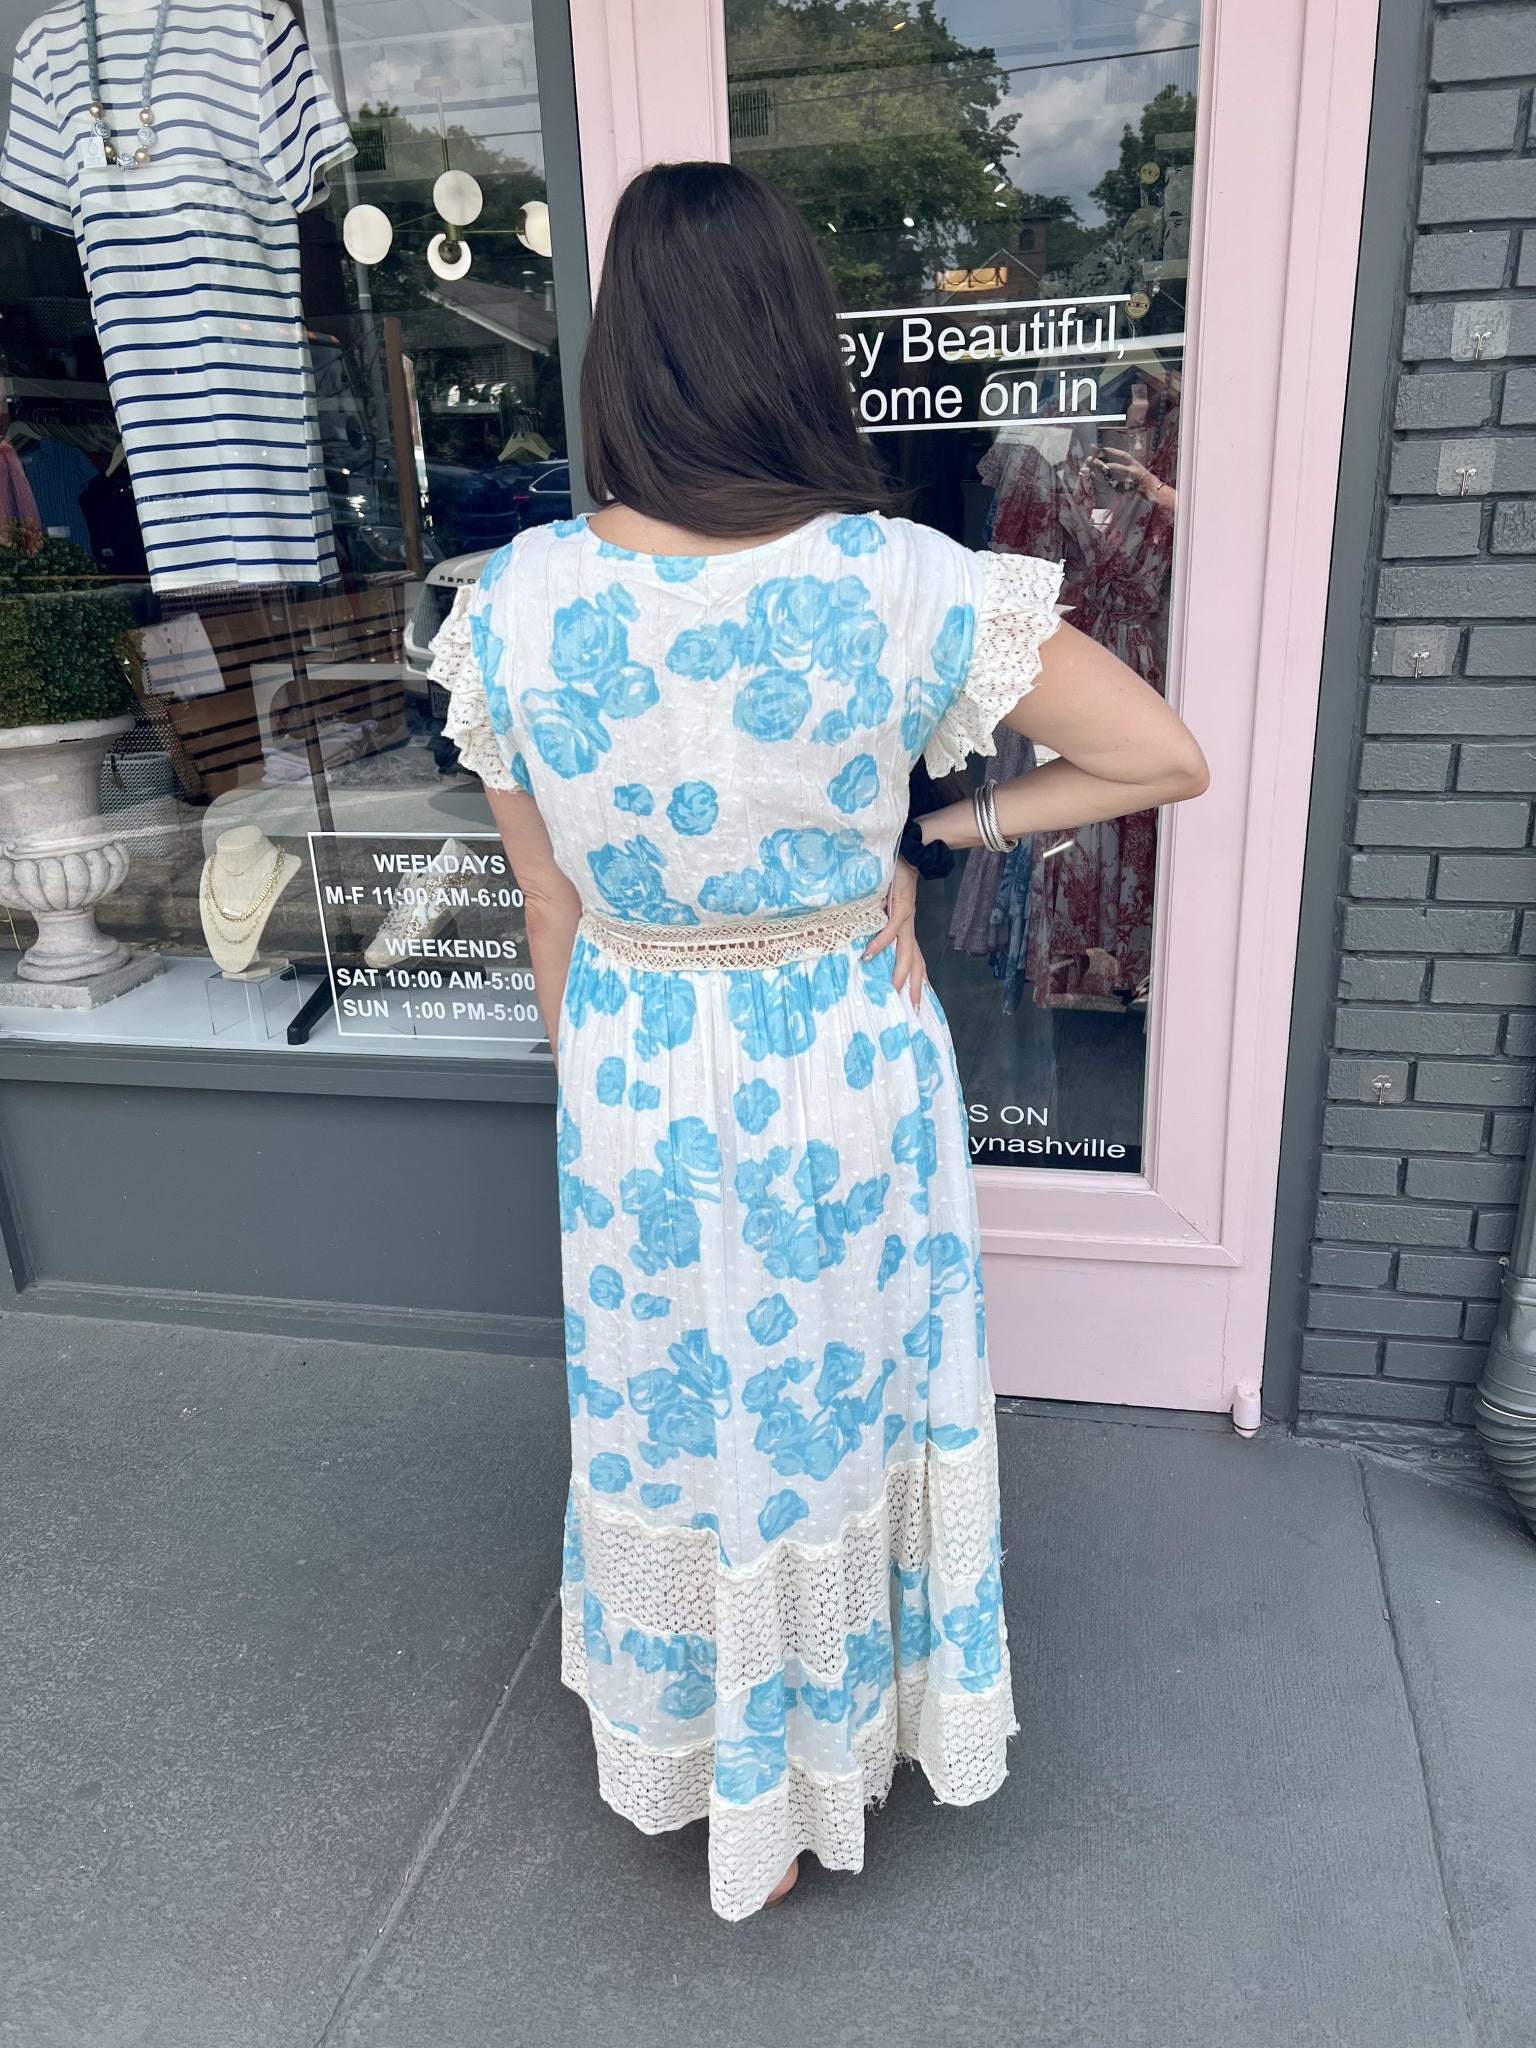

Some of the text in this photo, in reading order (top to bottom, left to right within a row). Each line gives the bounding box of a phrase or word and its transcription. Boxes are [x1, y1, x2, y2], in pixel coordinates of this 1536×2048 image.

[837, 305, 1125, 378] ey Beautiful,
[850, 370, 1097, 422] ome on in
[373, 854, 506, 875] WEEKDAYS
[325, 886, 524, 907] M-F 11:00 AM-6:00
[385, 938, 518, 960] WEEKENDS
[336, 968, 535, 991] SAT 10:00 AM-5:00
[343, 999, 539, 1021] SUN 1:00 PM-5:00
[1000, 1105, 1048, 1126] ON
[970, 1136, 1126, 1158] ynashville
